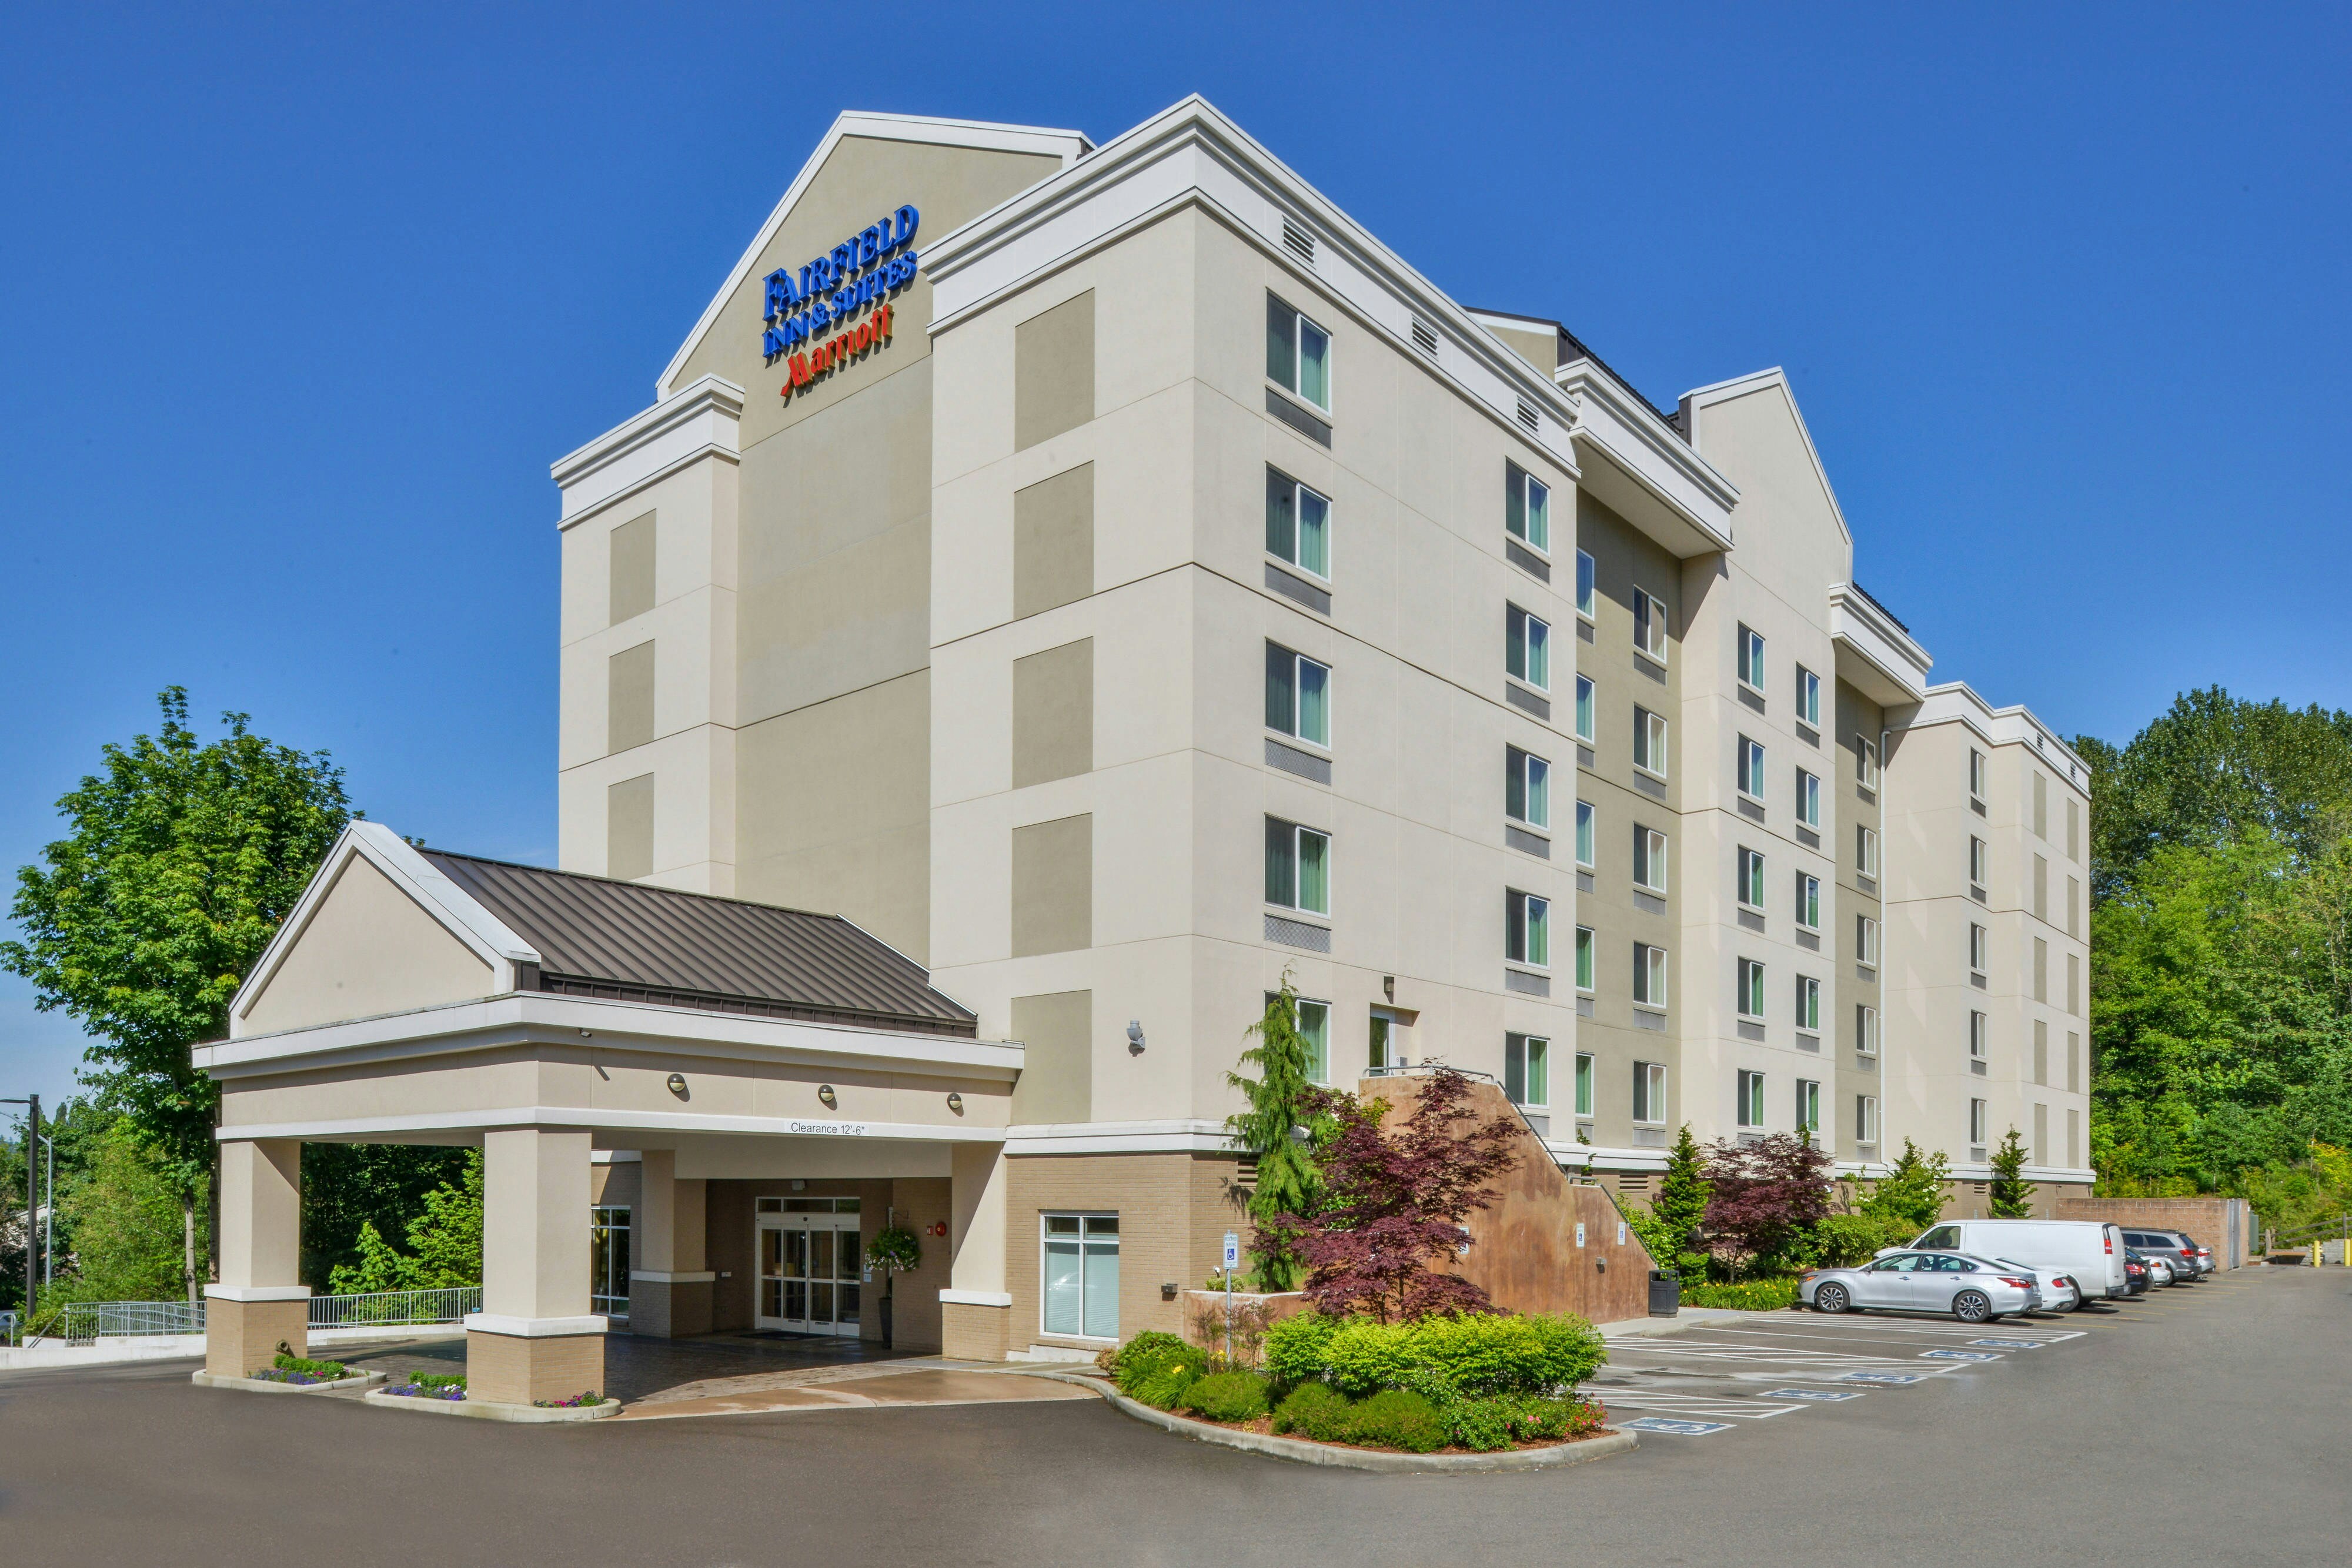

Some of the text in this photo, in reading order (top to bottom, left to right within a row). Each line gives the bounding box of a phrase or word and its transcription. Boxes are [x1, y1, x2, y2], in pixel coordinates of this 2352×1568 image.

[763, 205, 919, 321] FAIRFIELD
[780, 303, 894, 397] Marriott
[791, 1122, 837, 1134] Clearance
